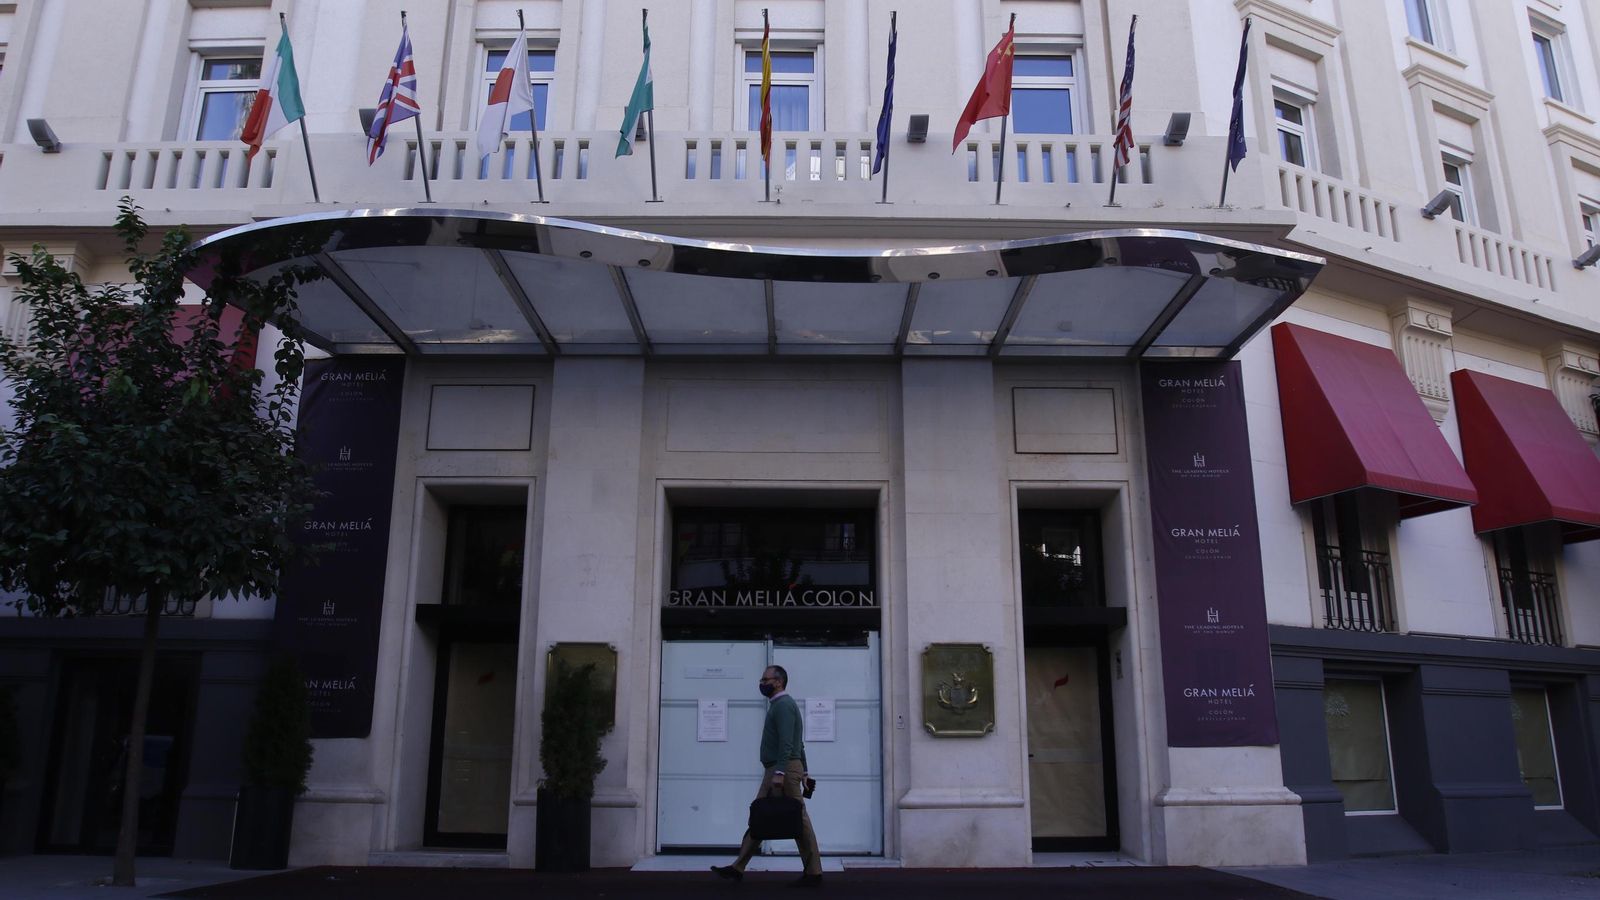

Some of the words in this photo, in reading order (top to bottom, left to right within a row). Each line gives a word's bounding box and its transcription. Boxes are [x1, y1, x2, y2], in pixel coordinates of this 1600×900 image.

[320, 372, 352, 381] GRAN
[355, 368, 386, 381] MELIÁ
[1158, 379, 1190, 387] GRAN
[1194, 375, 1225, 387] MELIÁ
[304, 520, 336, 530] GRAN
[339, 517, 372, 530] MELIÁ
[1171, 528, 1204, 537] GRAN
[1208, 524, 1241, 537] MELIÁ
[668, 590, 726, 606] GRAN
[802, 590, 874, 606] COLON
[321, 676, 356, 690] MELIÁ
[1183, 687, 1217, 698] GRAN
[1221, 683, 1255, 697] MELIÁ
